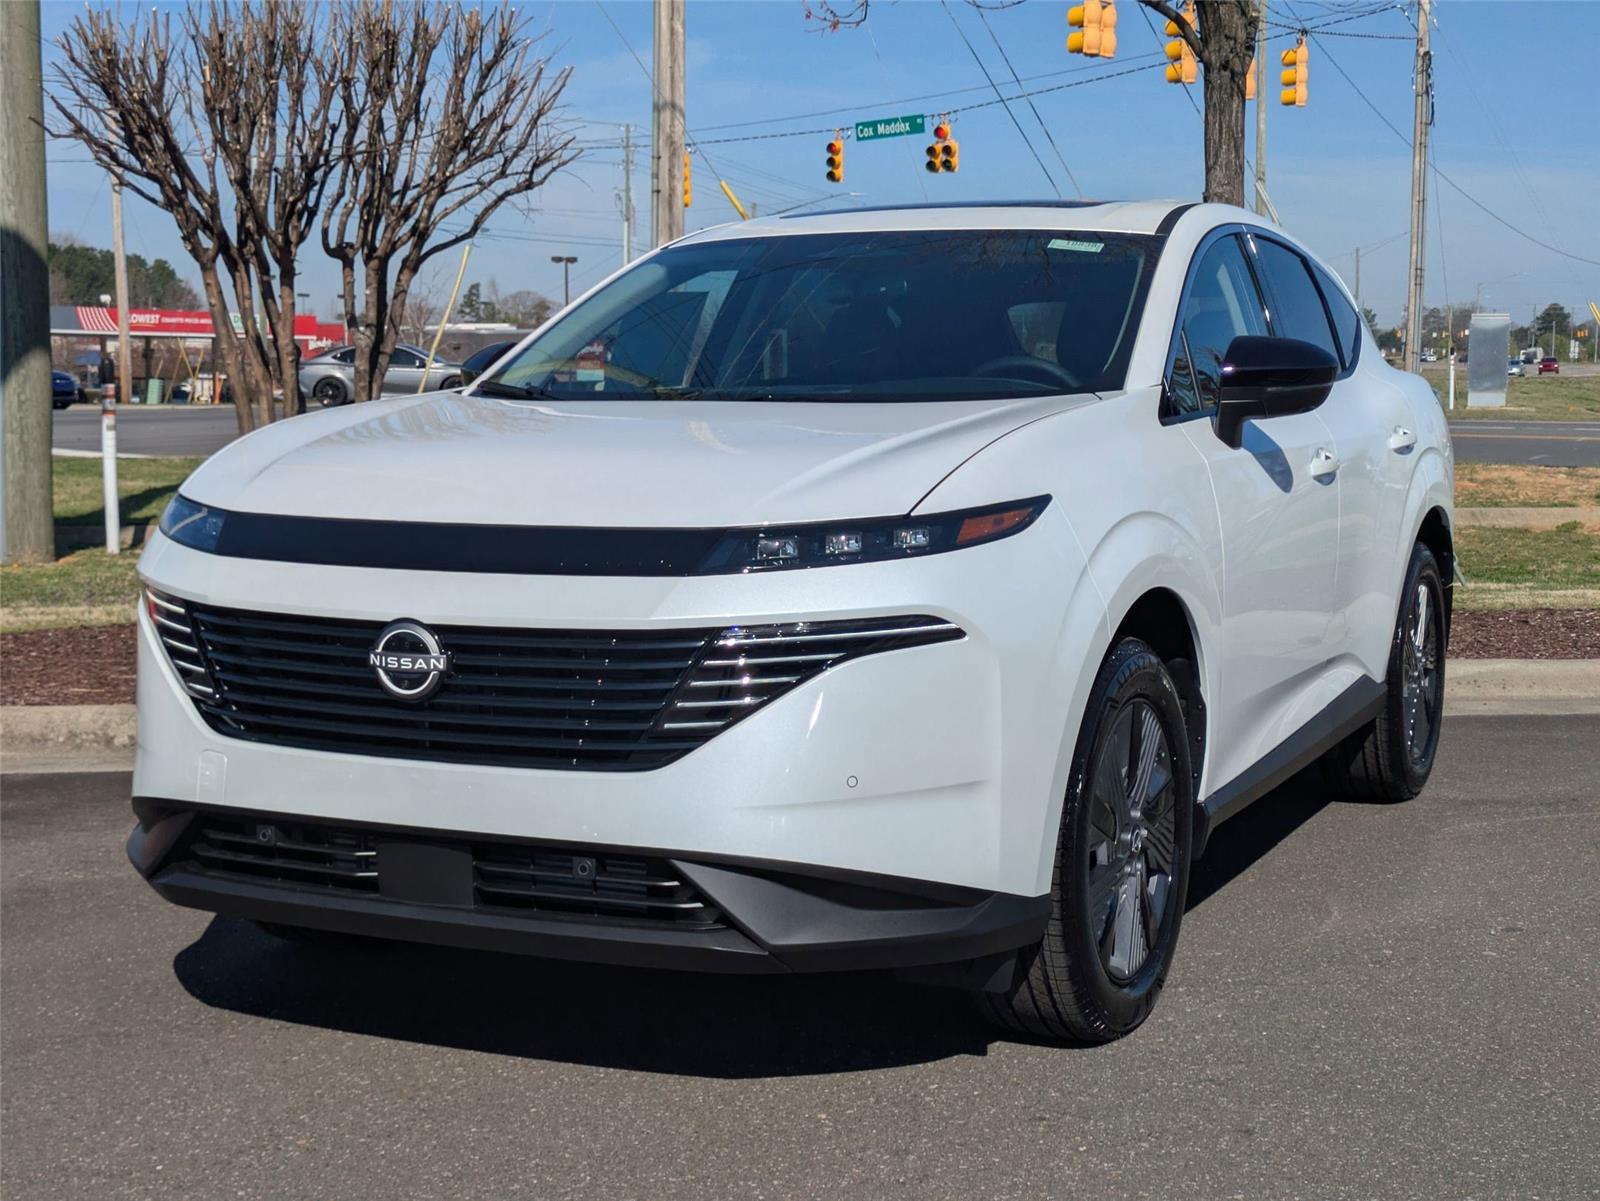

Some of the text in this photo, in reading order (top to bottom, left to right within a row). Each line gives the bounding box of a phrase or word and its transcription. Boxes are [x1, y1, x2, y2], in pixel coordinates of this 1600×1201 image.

[857, 125, 874, 138] Cox
[877, 121, 911, 135] Maddox
[370, 653, 444, 670] NISSAN
